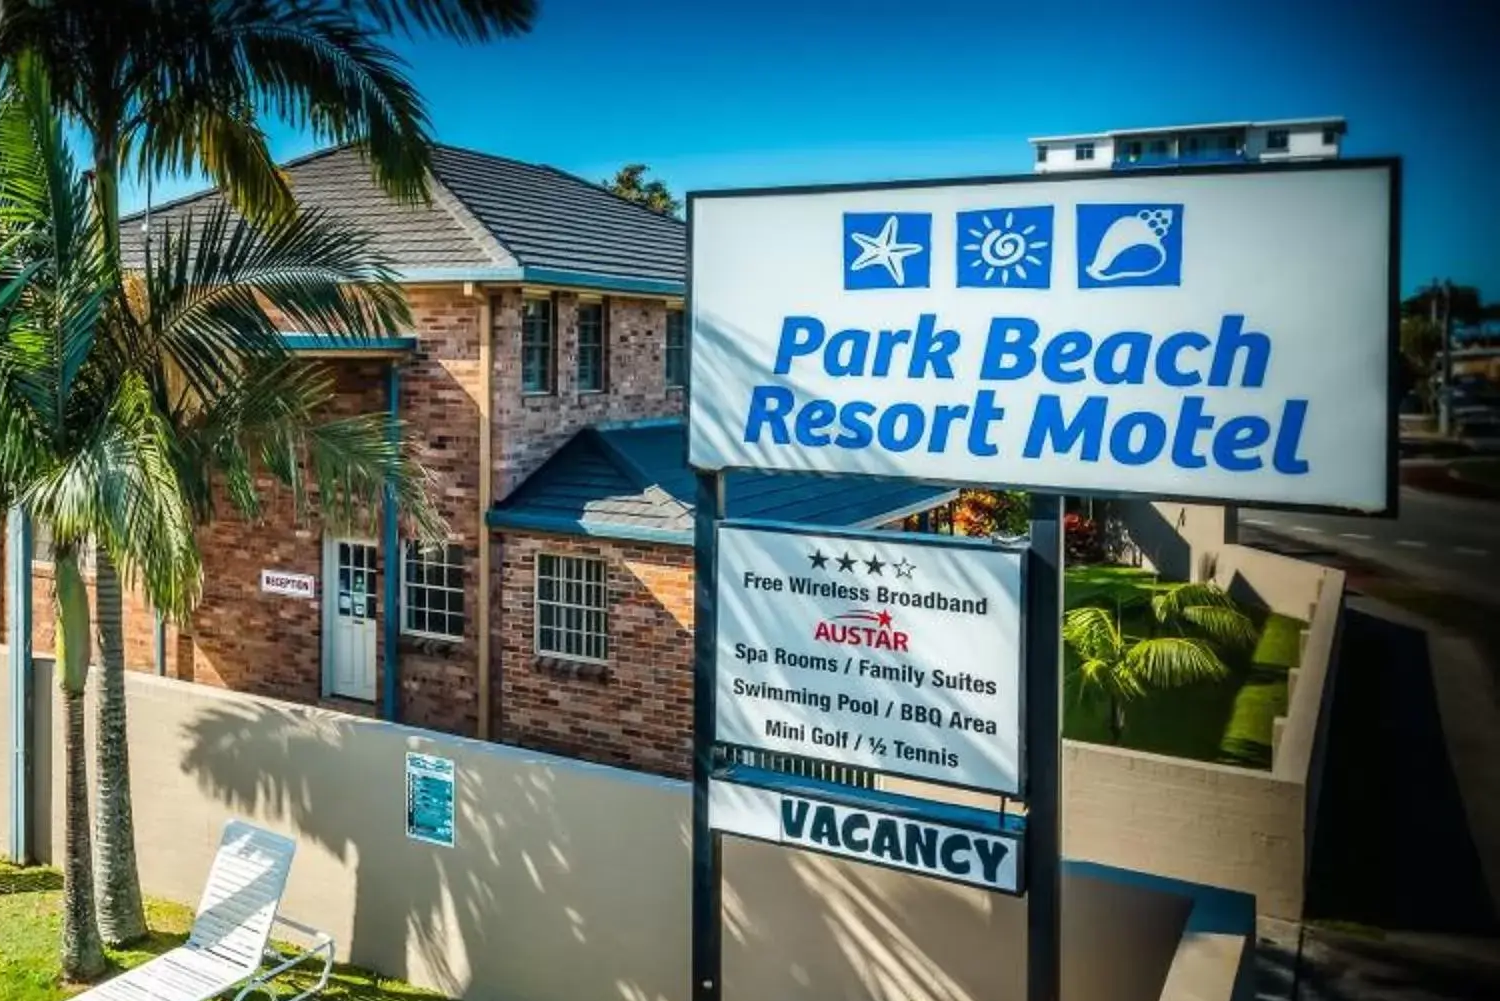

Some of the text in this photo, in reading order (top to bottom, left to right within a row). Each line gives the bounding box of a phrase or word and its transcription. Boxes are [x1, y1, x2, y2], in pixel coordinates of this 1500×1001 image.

[774, 313, 1272, 387] Park Beach
[744, 385, 1310, 475] Resort Motel
[265, 575, 309, 591] RECEPTION
[743, 571, 988, 615] Free Wireless Broadband
[814, 621, 909, 652] AUSTAR
[735, 643, 997, 695] Spa Rooms / Family Suites
[733, 678, 997, 735] Swimming Pool / BBQ Area
[765, 719, 805, 742] Mini
[811, 727, 849, 750] Golf
[854, 734, 863, 751] /
[893, 740, 959, 768] Tennis
[781, 799, 1008, 882] VACANCY
